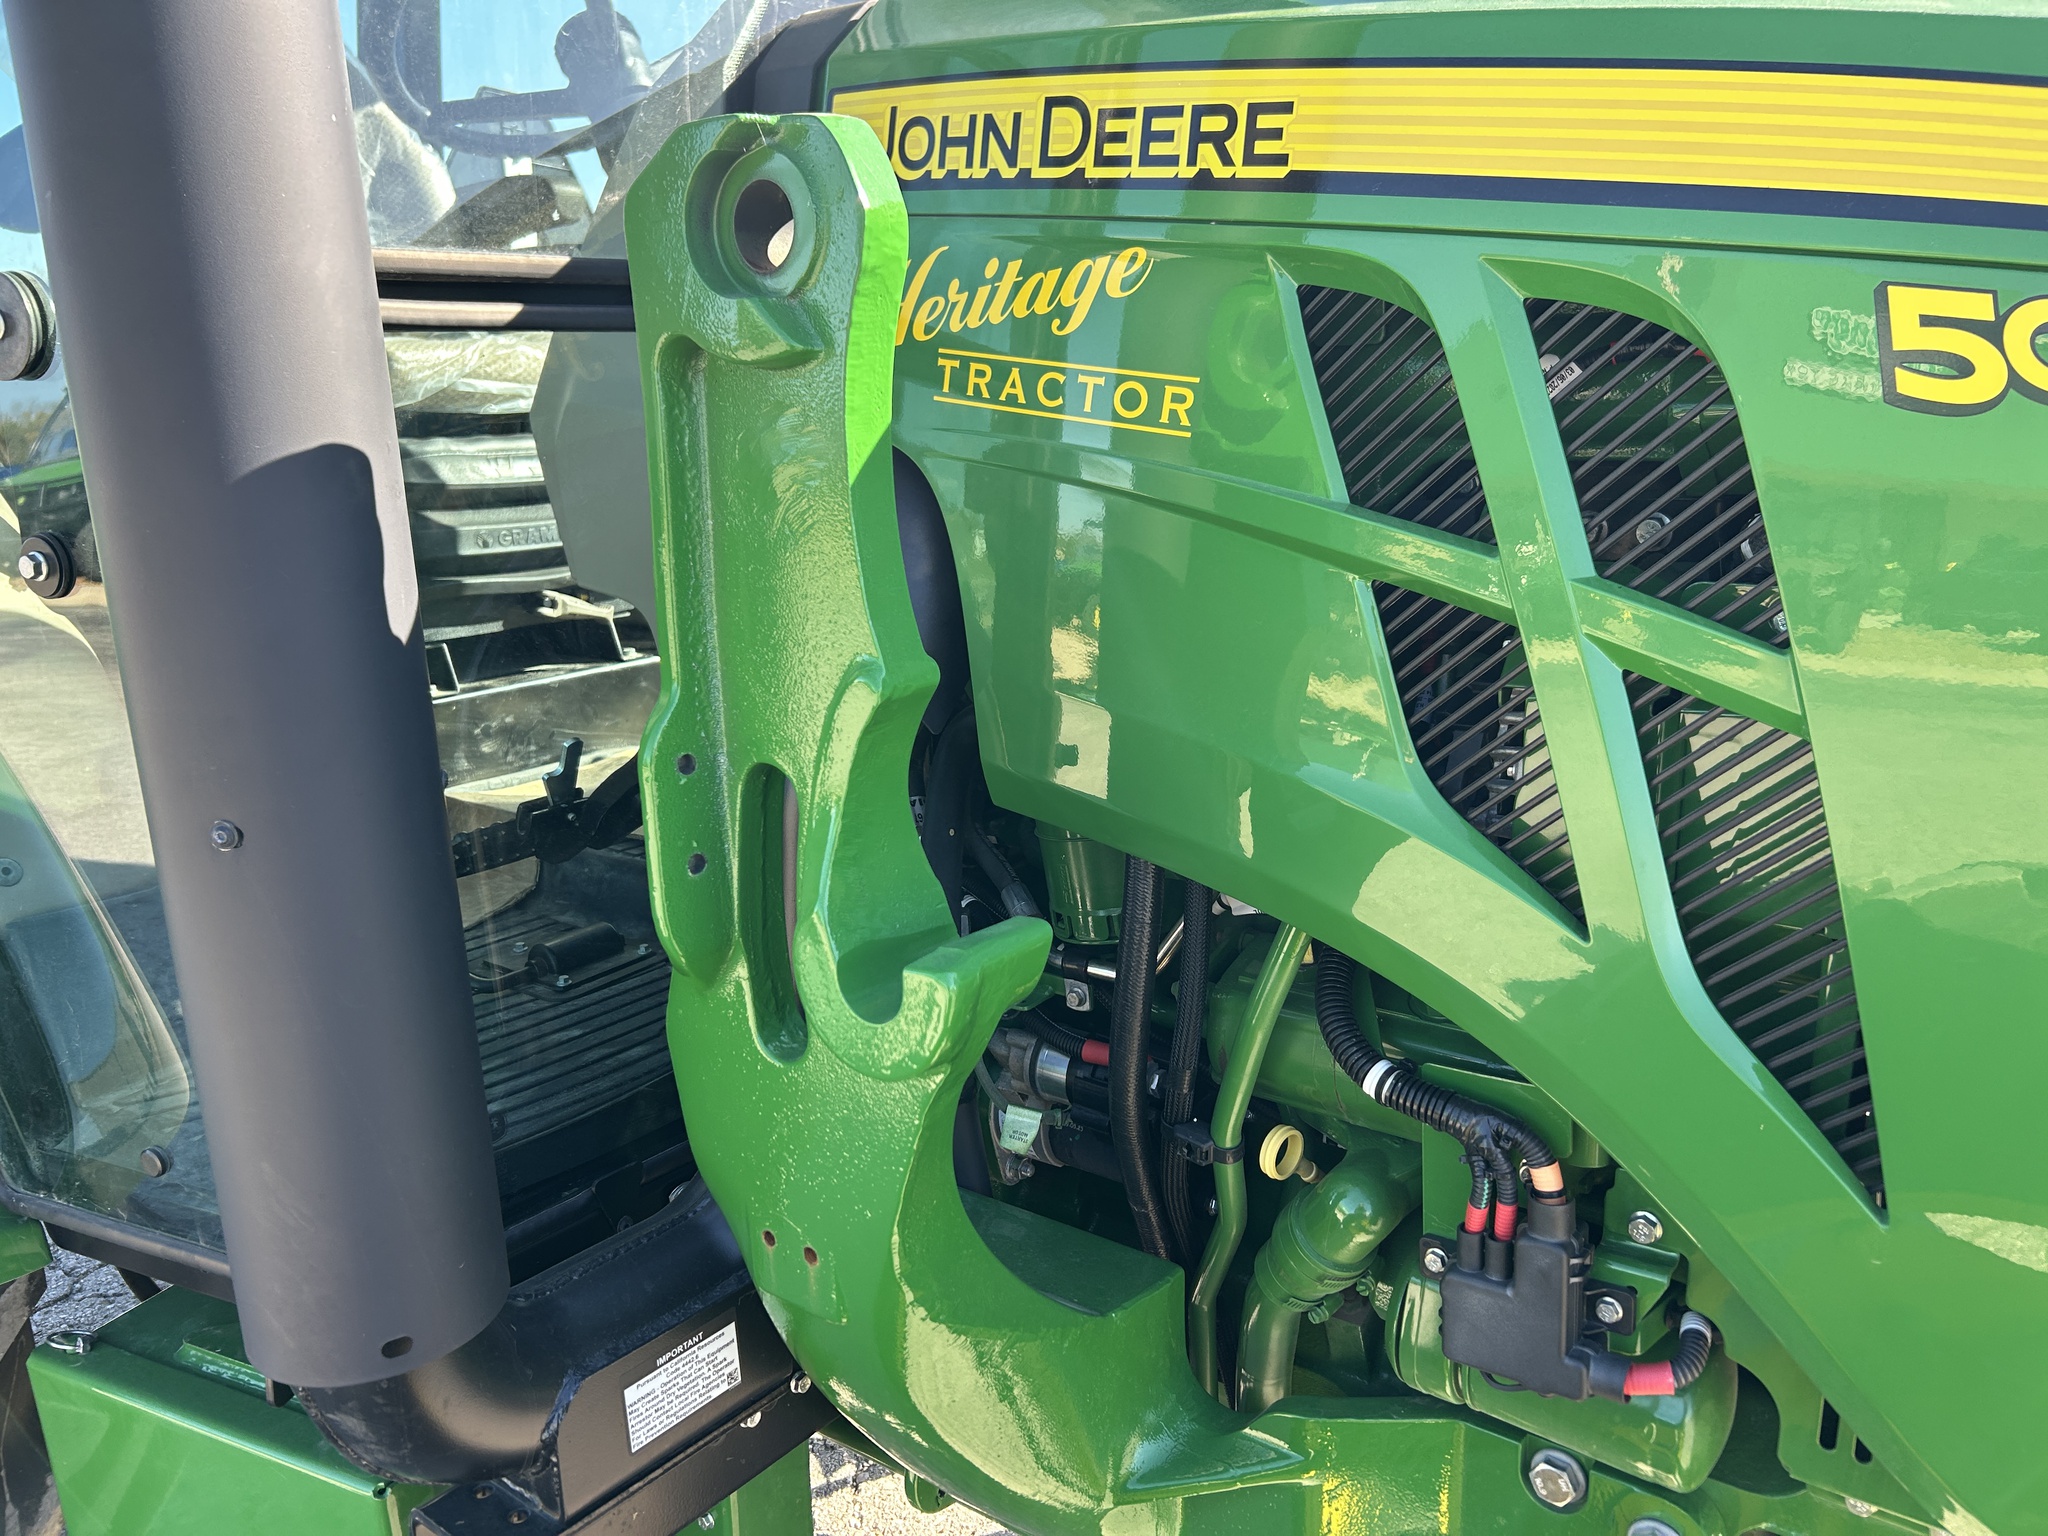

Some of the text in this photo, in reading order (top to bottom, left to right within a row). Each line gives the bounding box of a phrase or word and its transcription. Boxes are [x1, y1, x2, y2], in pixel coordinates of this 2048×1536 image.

[886, 95, 1294, 172] JOHN DEERE
[937, 357, 1195, 427] TRACTOR
[1546, 366, 1575, 395] 03/06/202
[656, 1331, 703, 1367] IMPORTANT
[627, 1388, 656, 1409] WARNING
